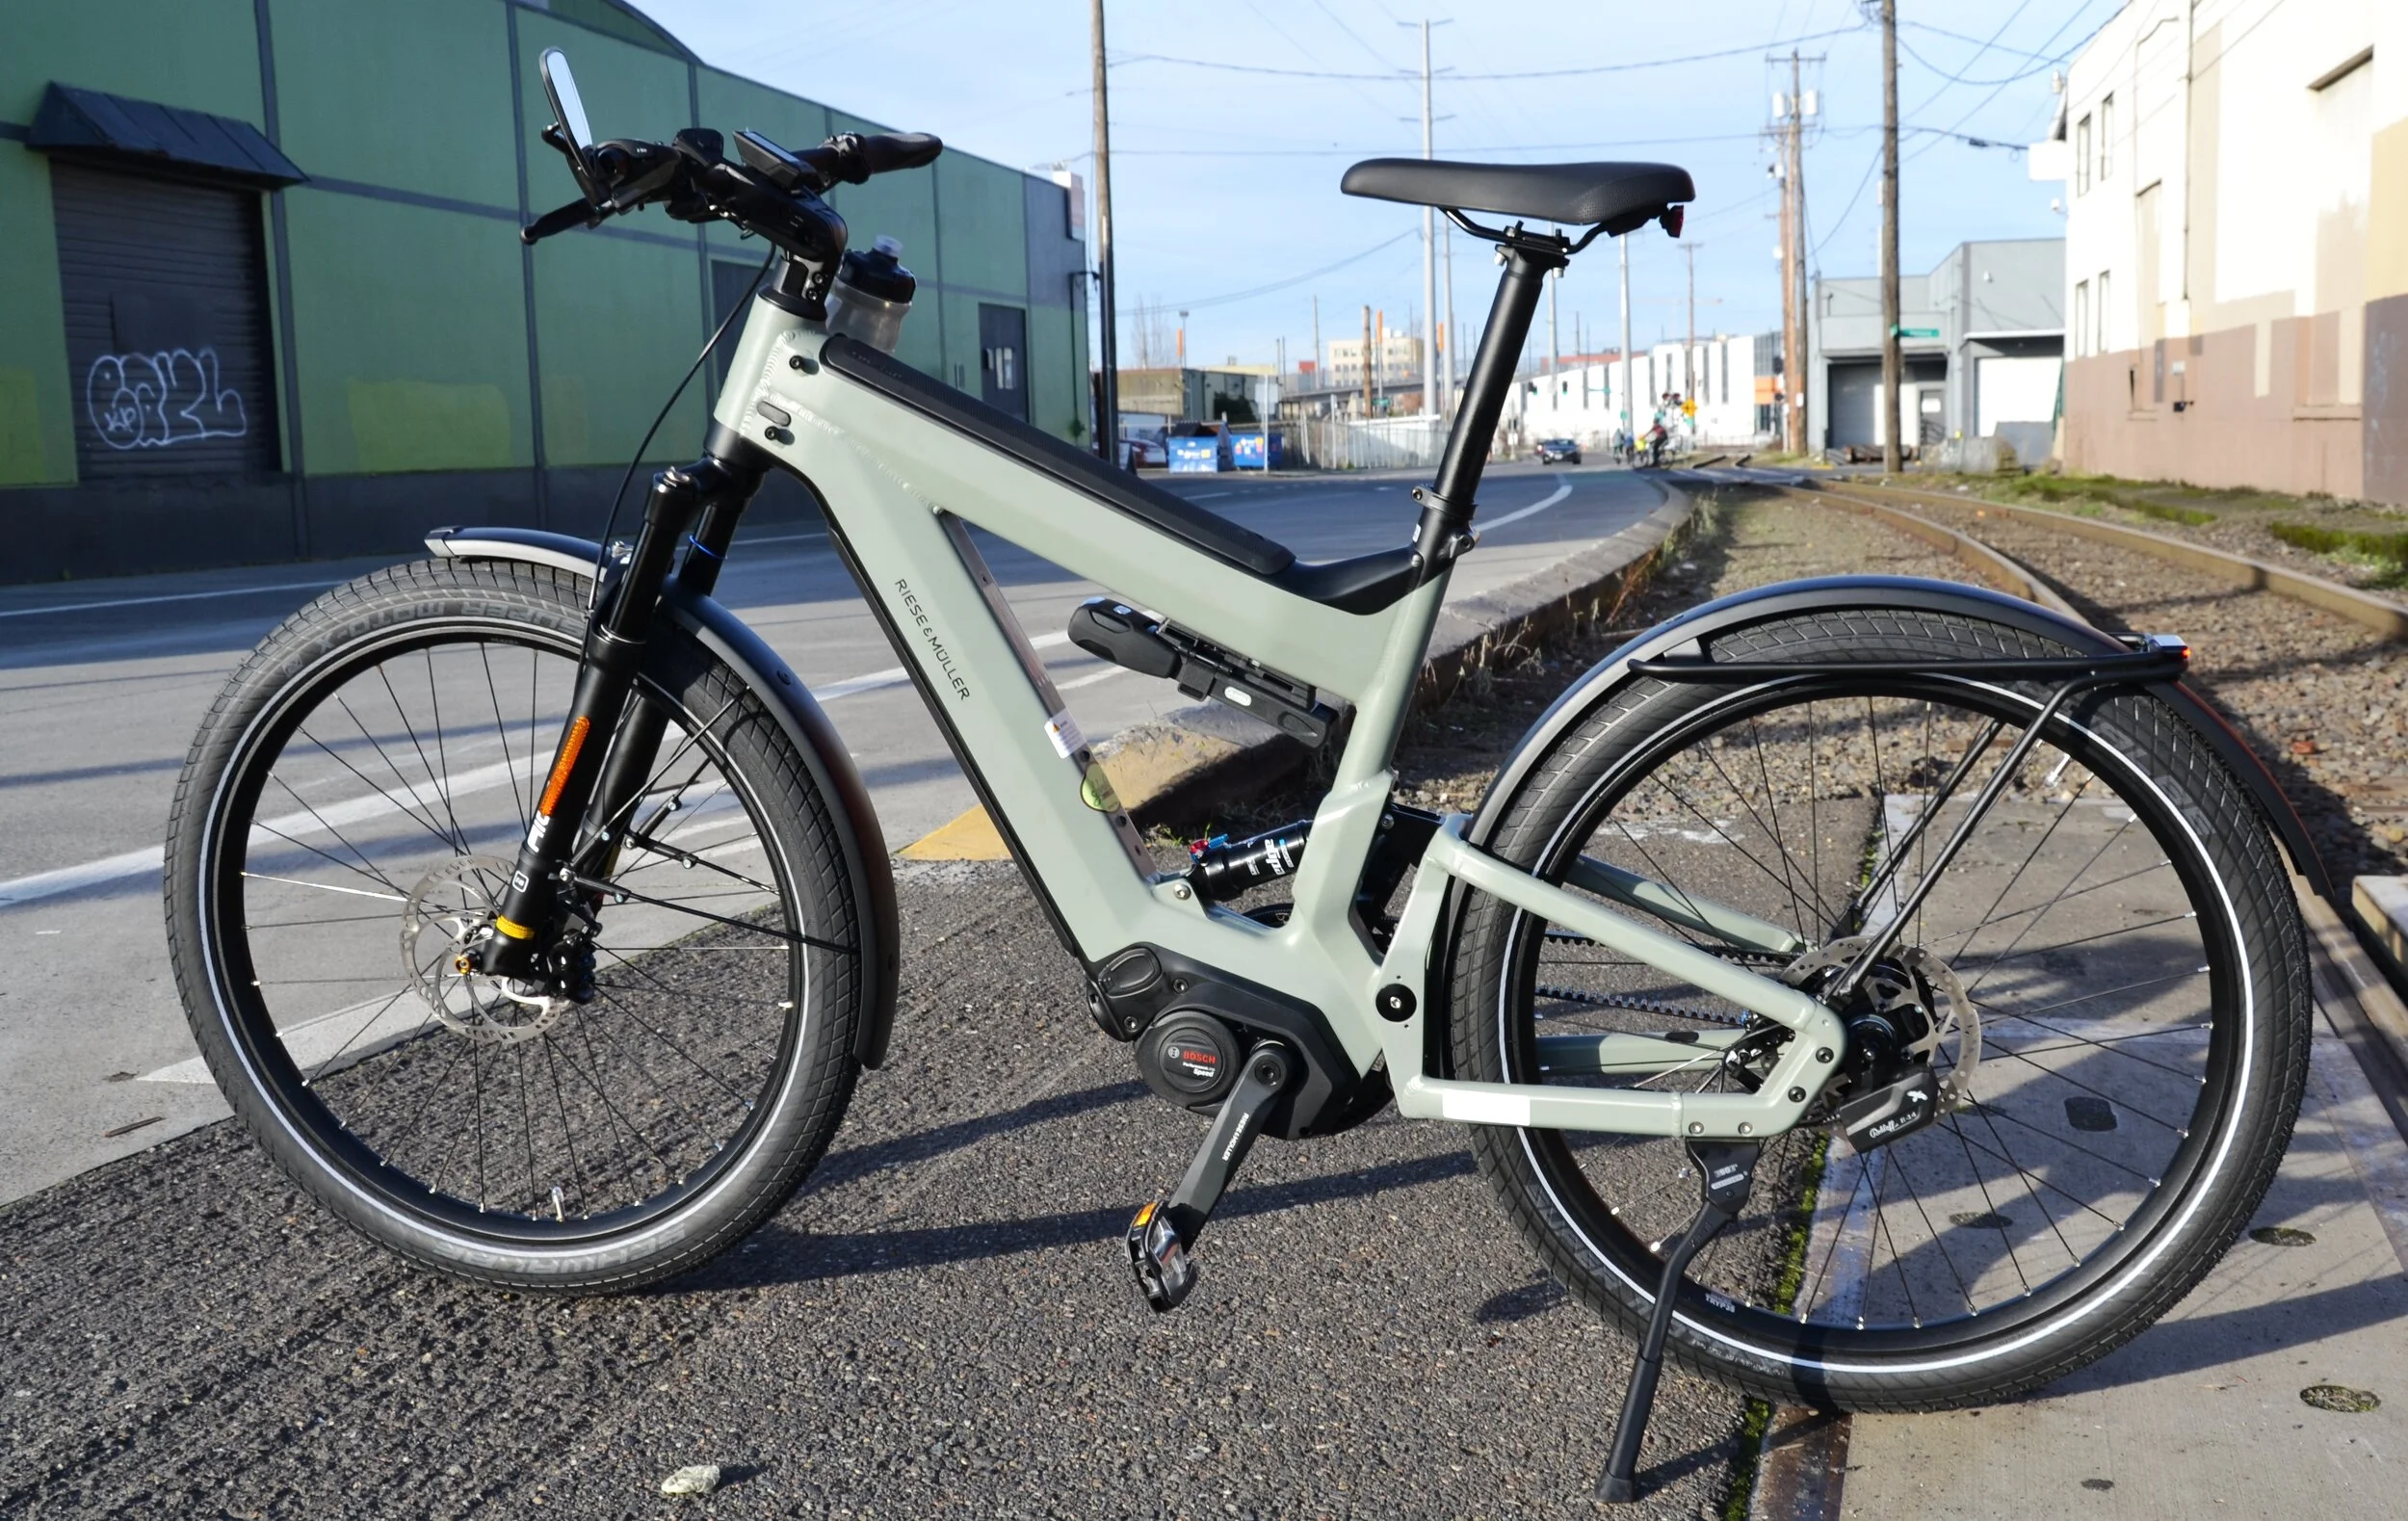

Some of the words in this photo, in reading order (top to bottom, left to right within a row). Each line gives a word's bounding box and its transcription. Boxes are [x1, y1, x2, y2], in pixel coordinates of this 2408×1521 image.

[894, 578, 929, 627] RIESE
[928, 636, 970, 701] MÜLLER
[1183, 1050, 1217, 1063] BOSCH
[1192, 1068, 1214, 1077] Speed
[1235, 1112, 1249, 1134] RIESE
